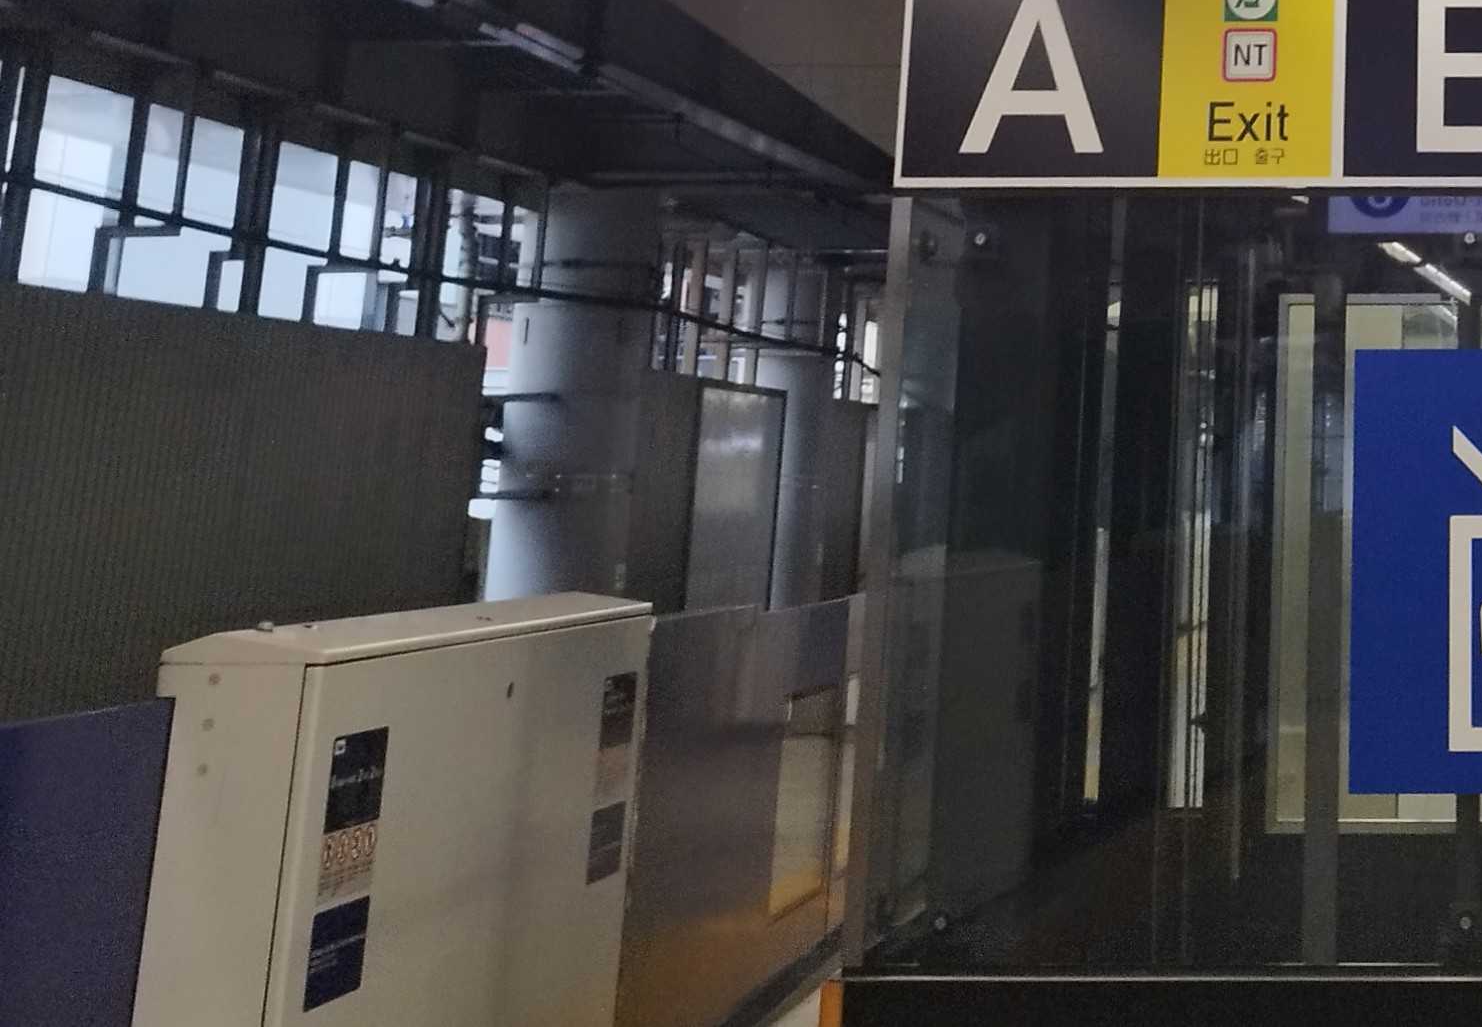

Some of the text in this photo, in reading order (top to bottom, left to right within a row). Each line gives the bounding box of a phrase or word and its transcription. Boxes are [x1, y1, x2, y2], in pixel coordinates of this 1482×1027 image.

[1234, 43, 1268, 66] NT
[1207, 101, 1289, 142] Exit
[1204, 148, 1239, 165] 出口
